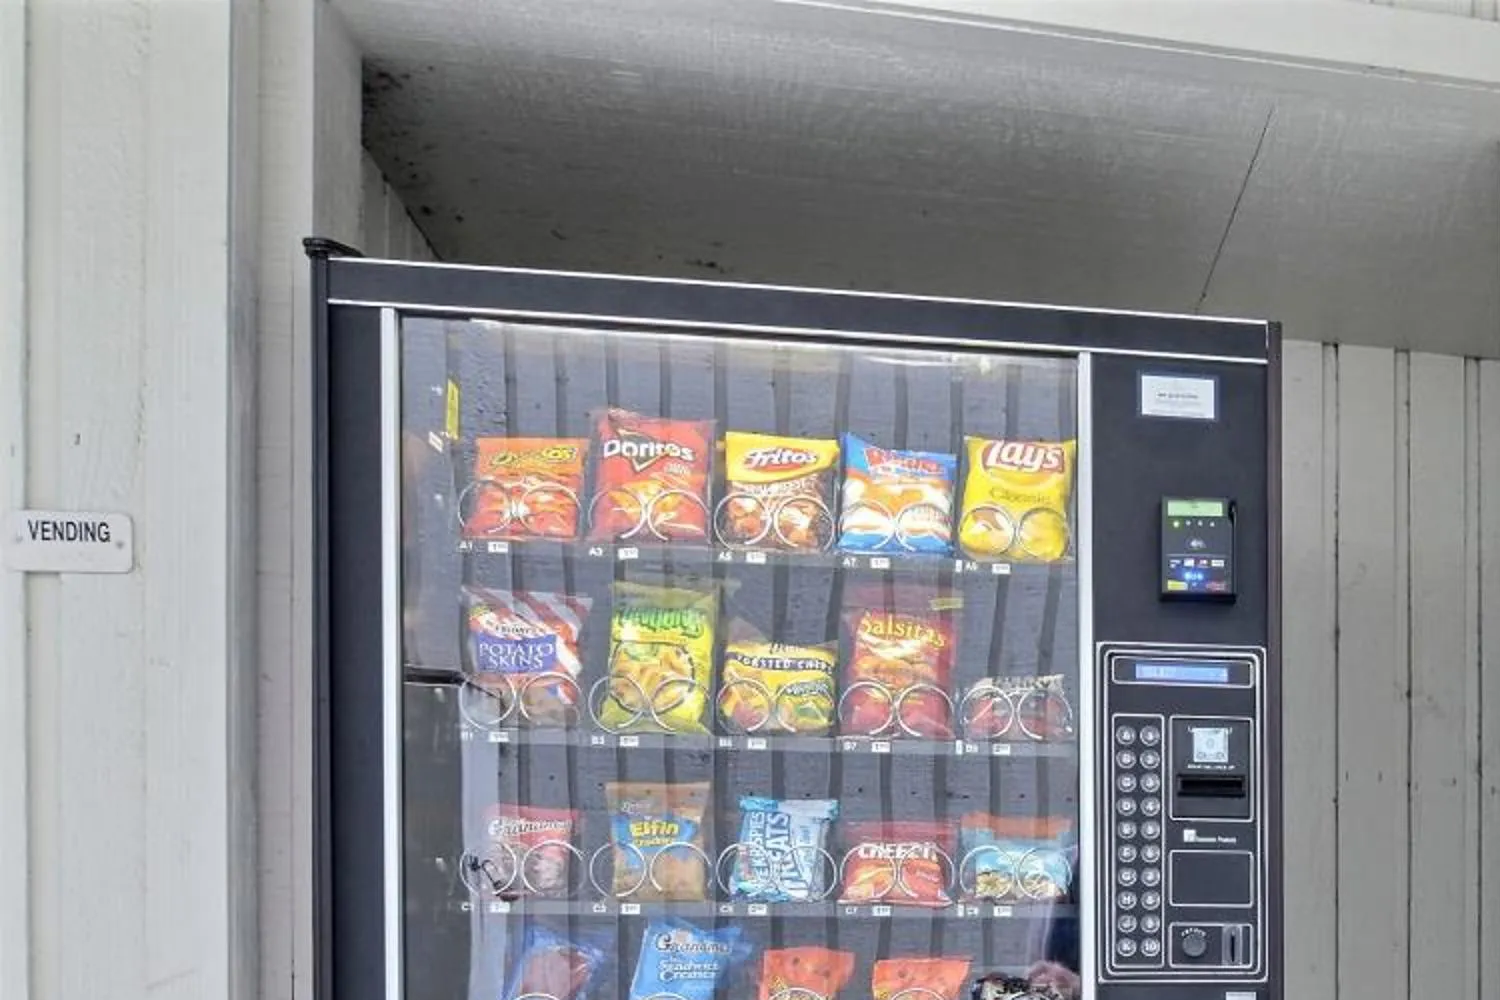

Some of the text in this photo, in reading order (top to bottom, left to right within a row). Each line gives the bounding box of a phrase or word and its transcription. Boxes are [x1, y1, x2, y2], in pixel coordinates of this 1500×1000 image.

[603, 439, 695, 461] Doritos
[744, 446, 817, 467] Fritos
[27, 520, 111, 542] VENDING
[861, 609, 945, 648] Salsitas
[479, 642, 553, 657] POTATO
[489, 656, 543, 669] SKINS
